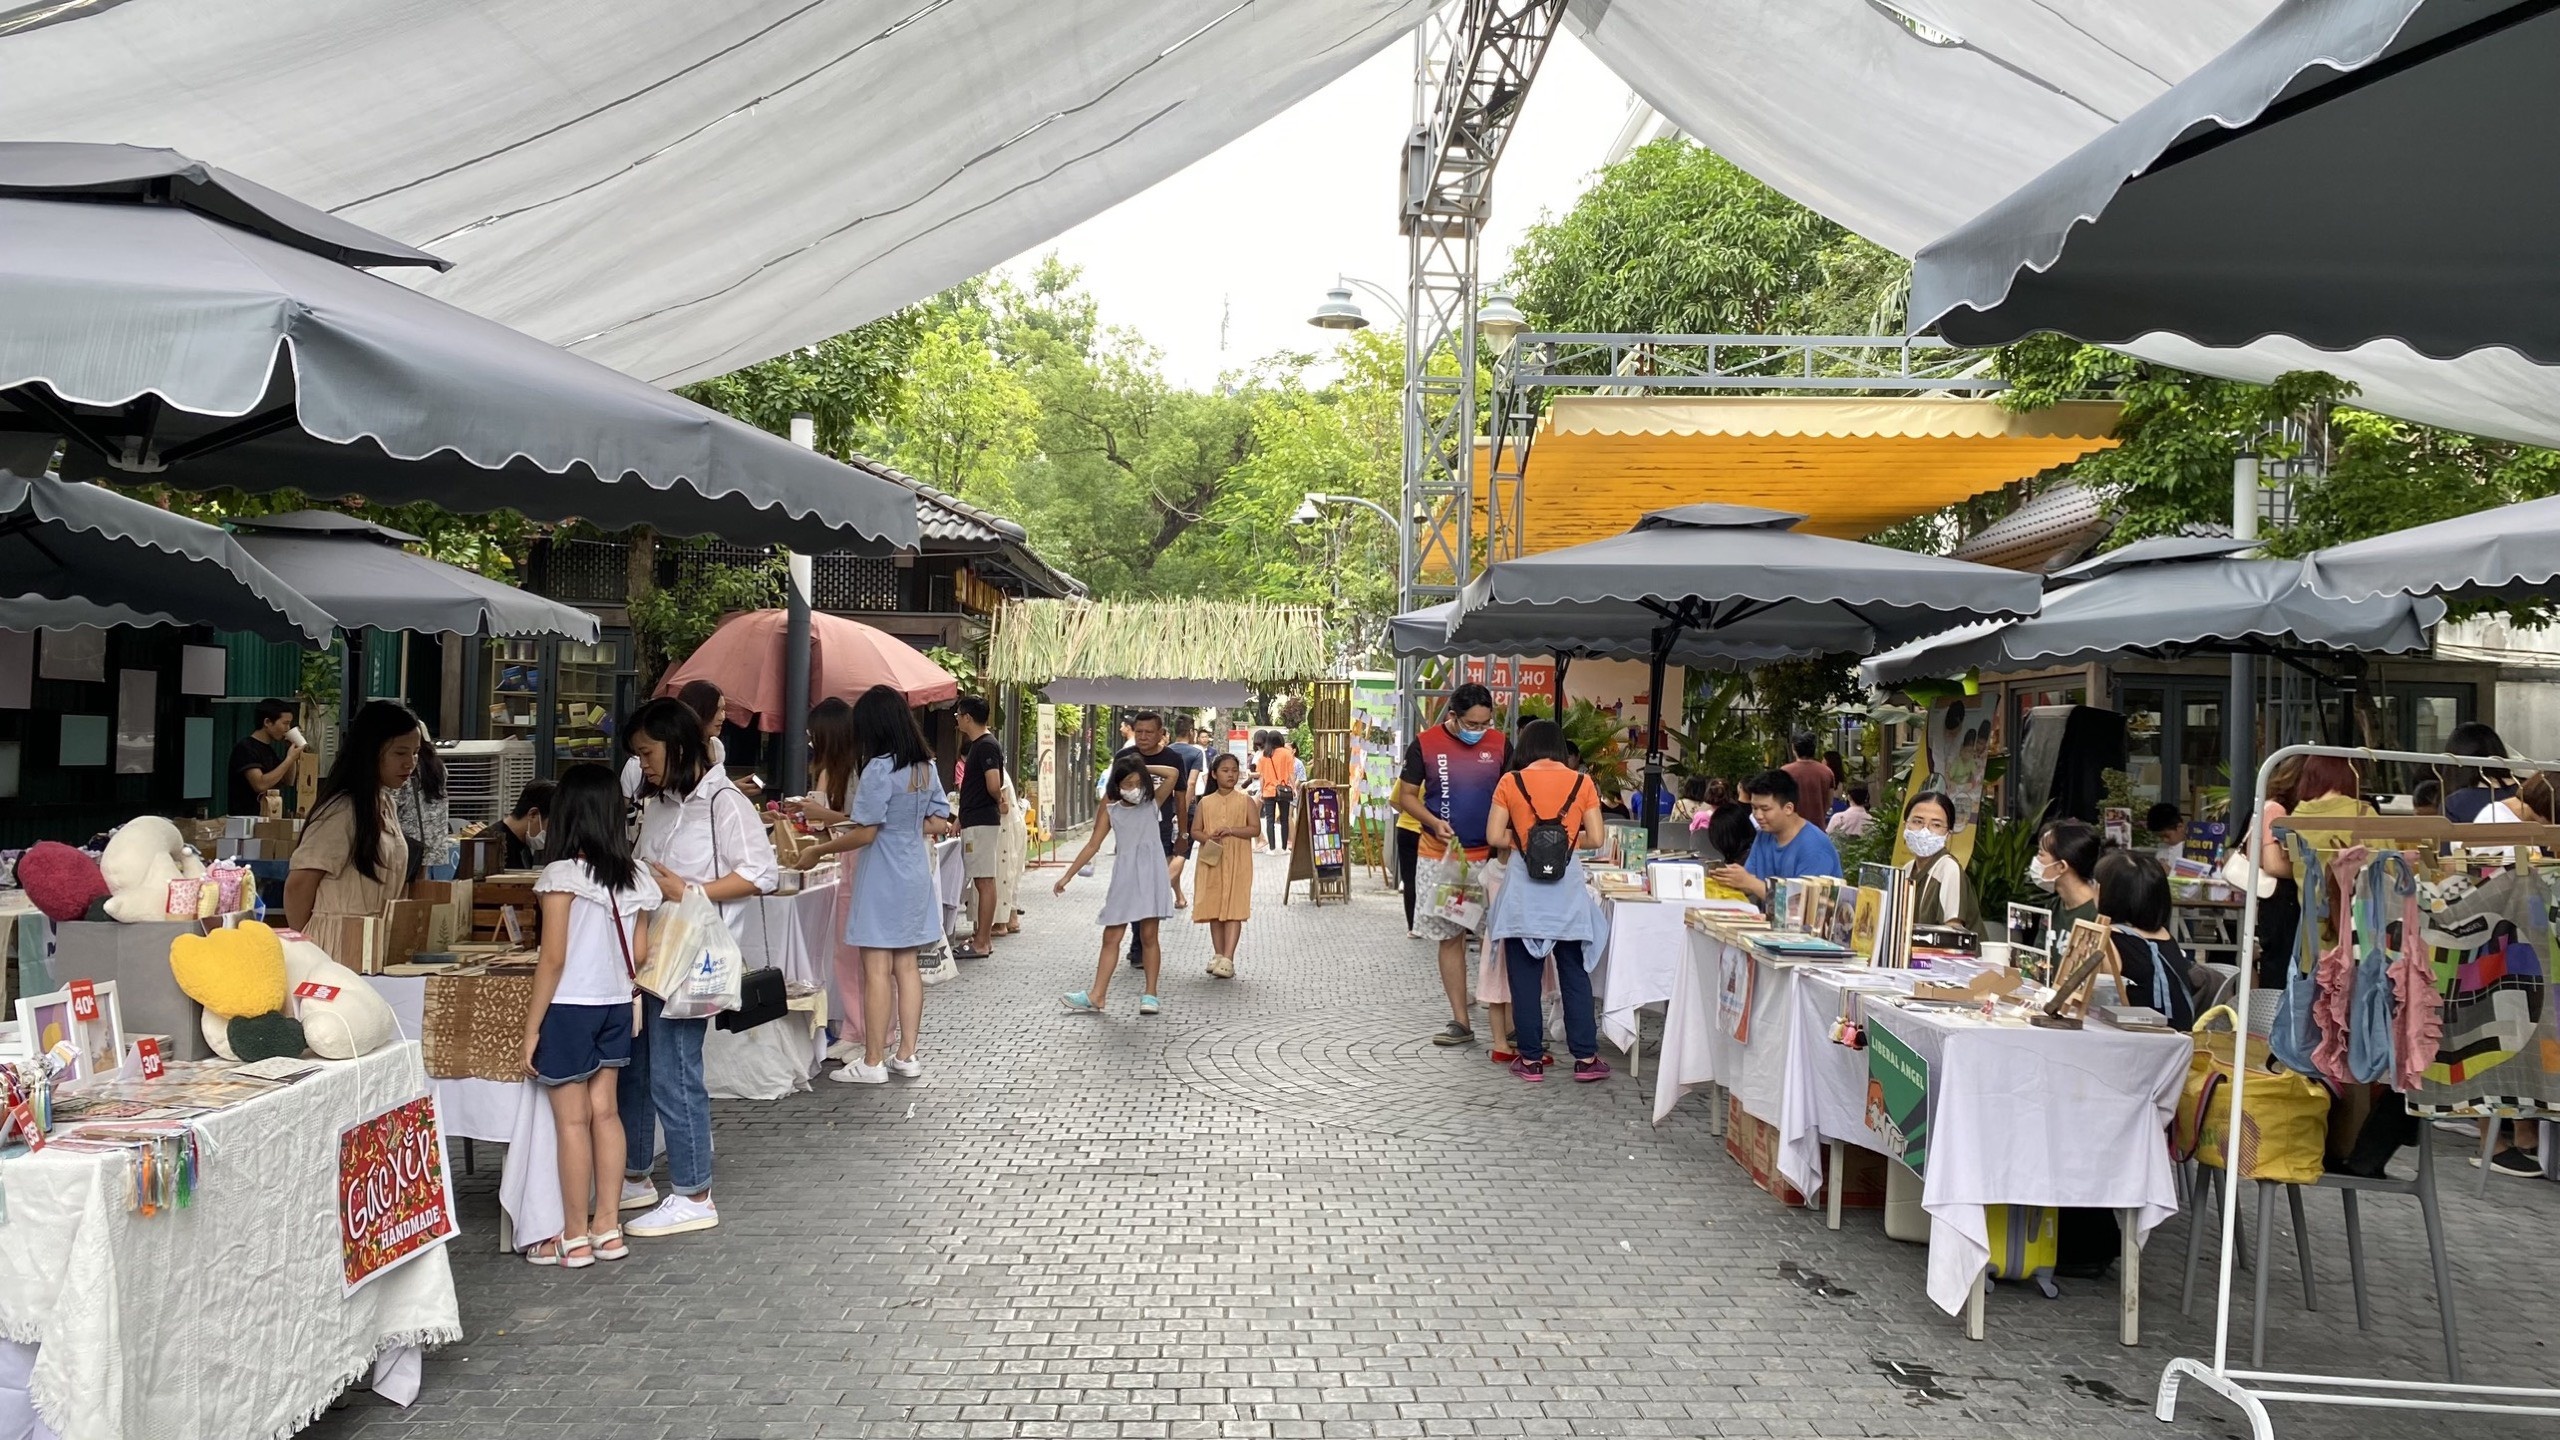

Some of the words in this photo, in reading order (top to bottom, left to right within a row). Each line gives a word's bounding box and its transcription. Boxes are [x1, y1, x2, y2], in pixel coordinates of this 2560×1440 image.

[1437, 753, 1450, 799] EDURUN
[1440, 801, 1451, 823] 202
[1871, 1035, 1900, 1070] LIBERAL
[1901, 1060, 1925, 1091] ANGEL
[380, 1204, 441, 1250] HANDMADE
